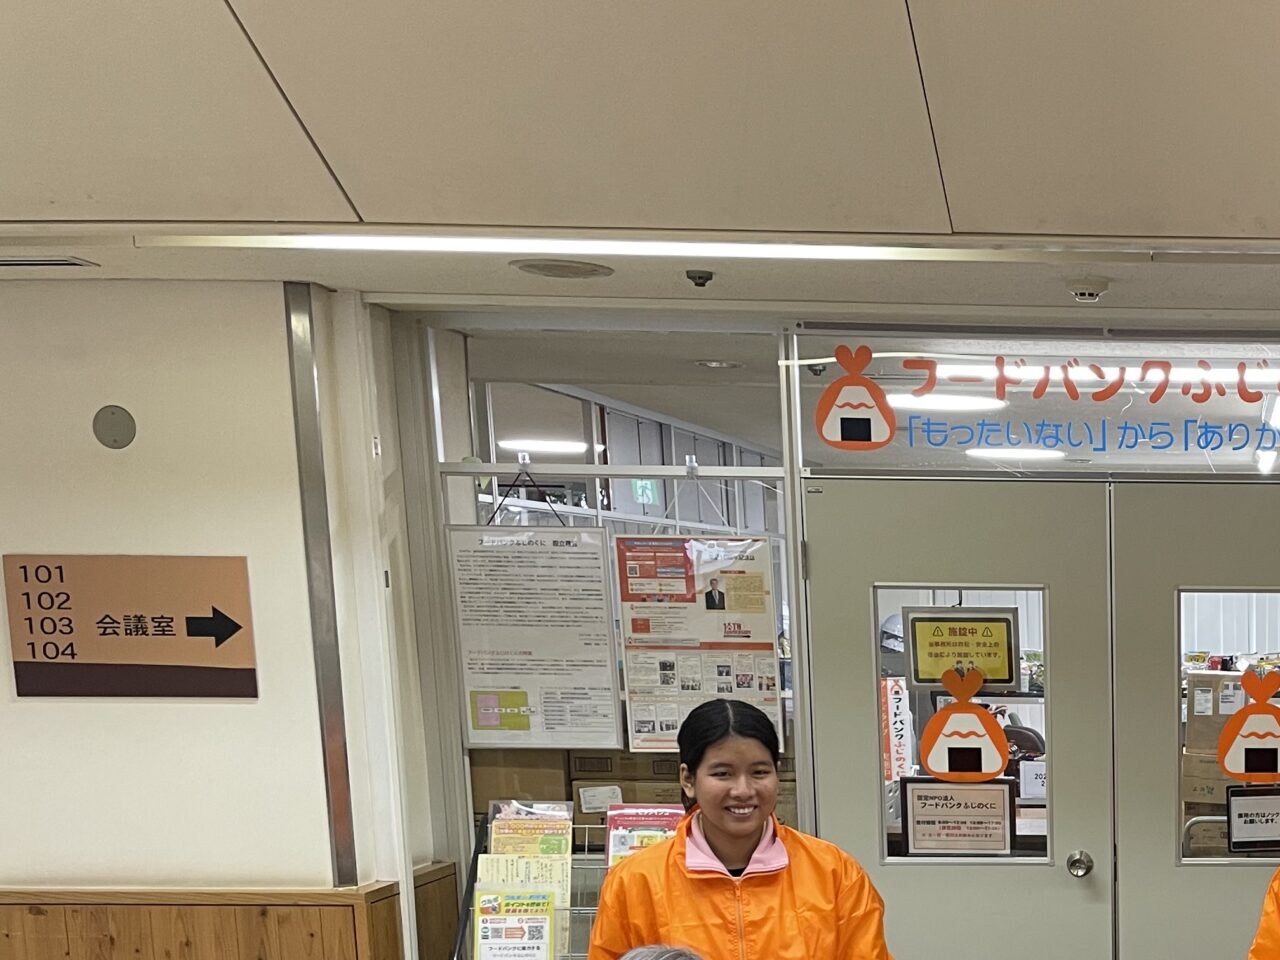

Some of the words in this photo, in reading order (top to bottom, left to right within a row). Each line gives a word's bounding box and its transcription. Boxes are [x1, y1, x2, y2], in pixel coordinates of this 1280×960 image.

[19, 565, 65, 584] 101
[21, 592, 72, 610] 102
[23, 616, 75, 636] 103
[95, 614, 177, 637] 会議室
[26, 641, 78, 660] 104
